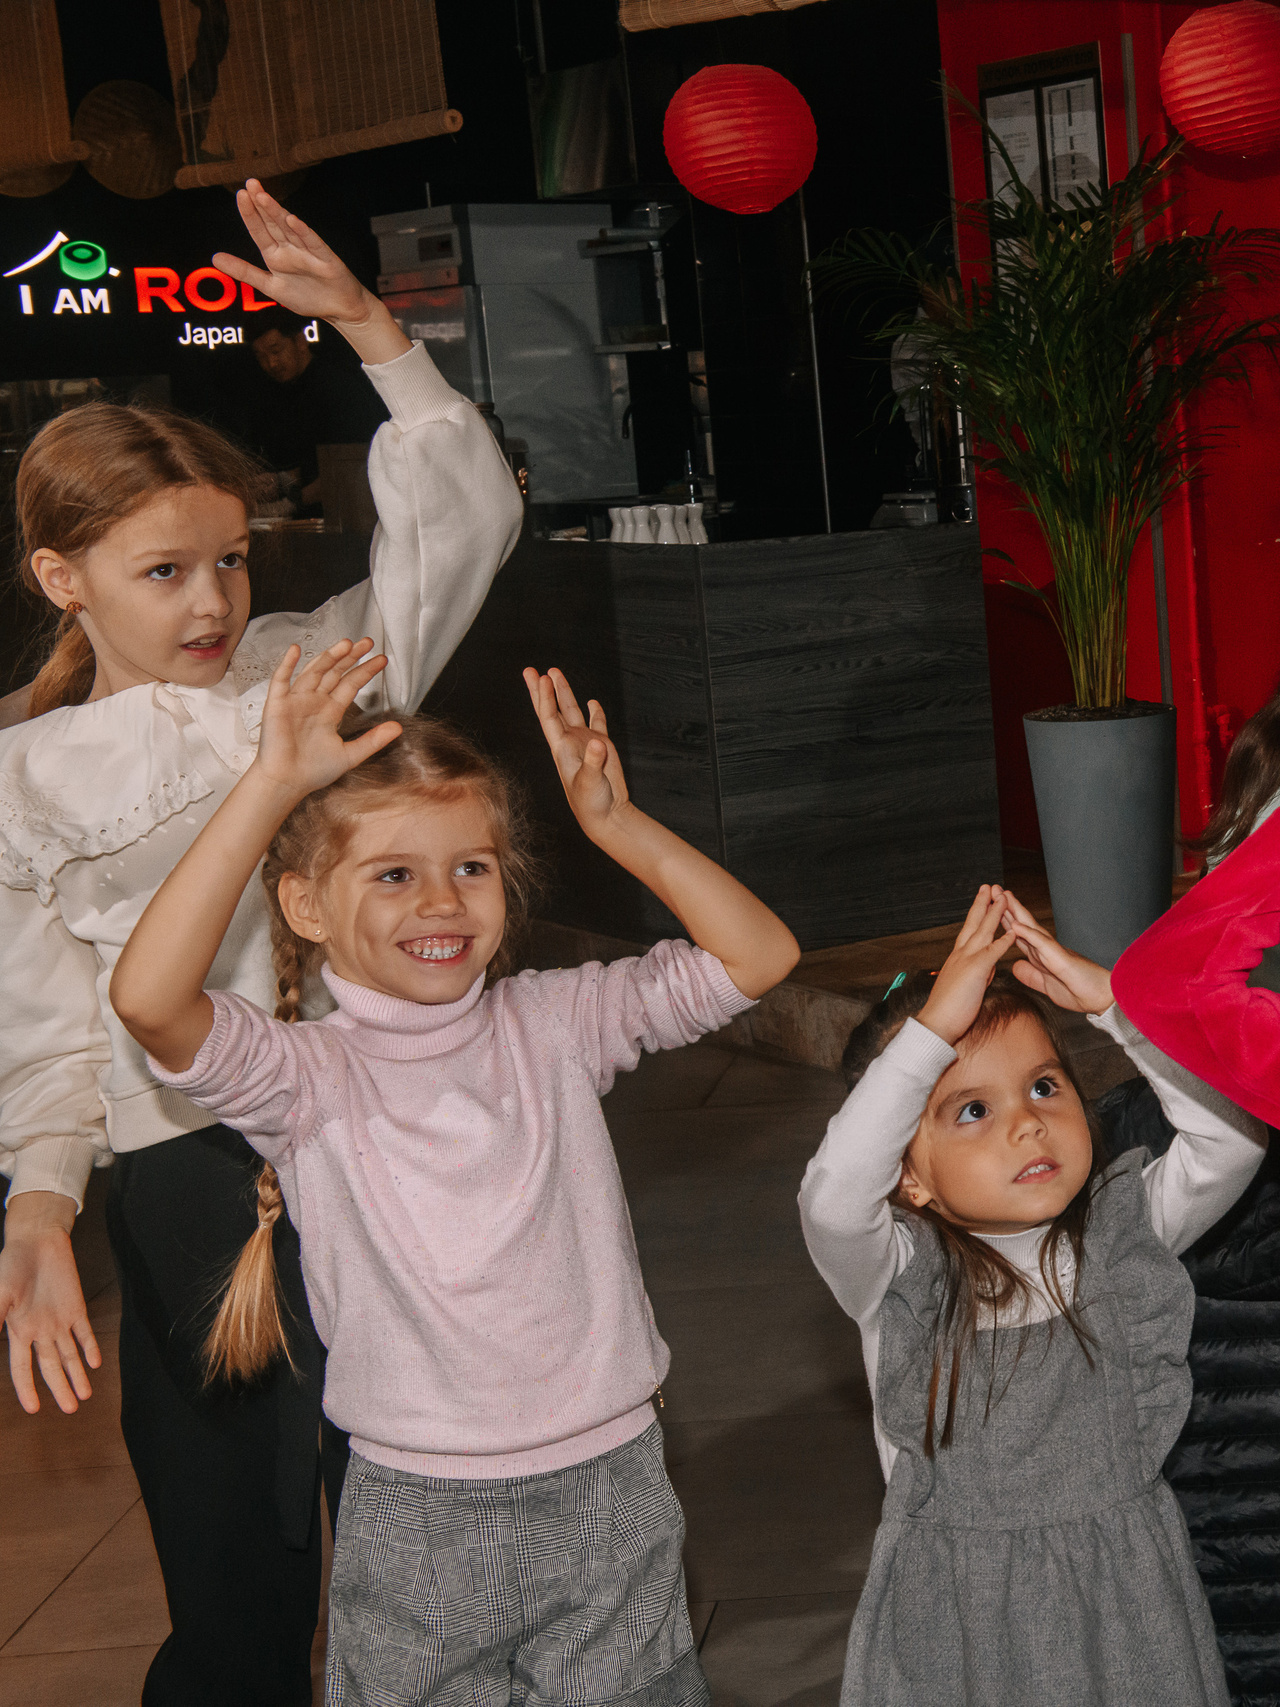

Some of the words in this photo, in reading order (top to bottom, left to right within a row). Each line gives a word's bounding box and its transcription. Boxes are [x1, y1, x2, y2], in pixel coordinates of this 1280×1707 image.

[19, 284, 34, 315] I
[53, 288, 111, 314] AM
[133, 266, 284, 313] ROL
